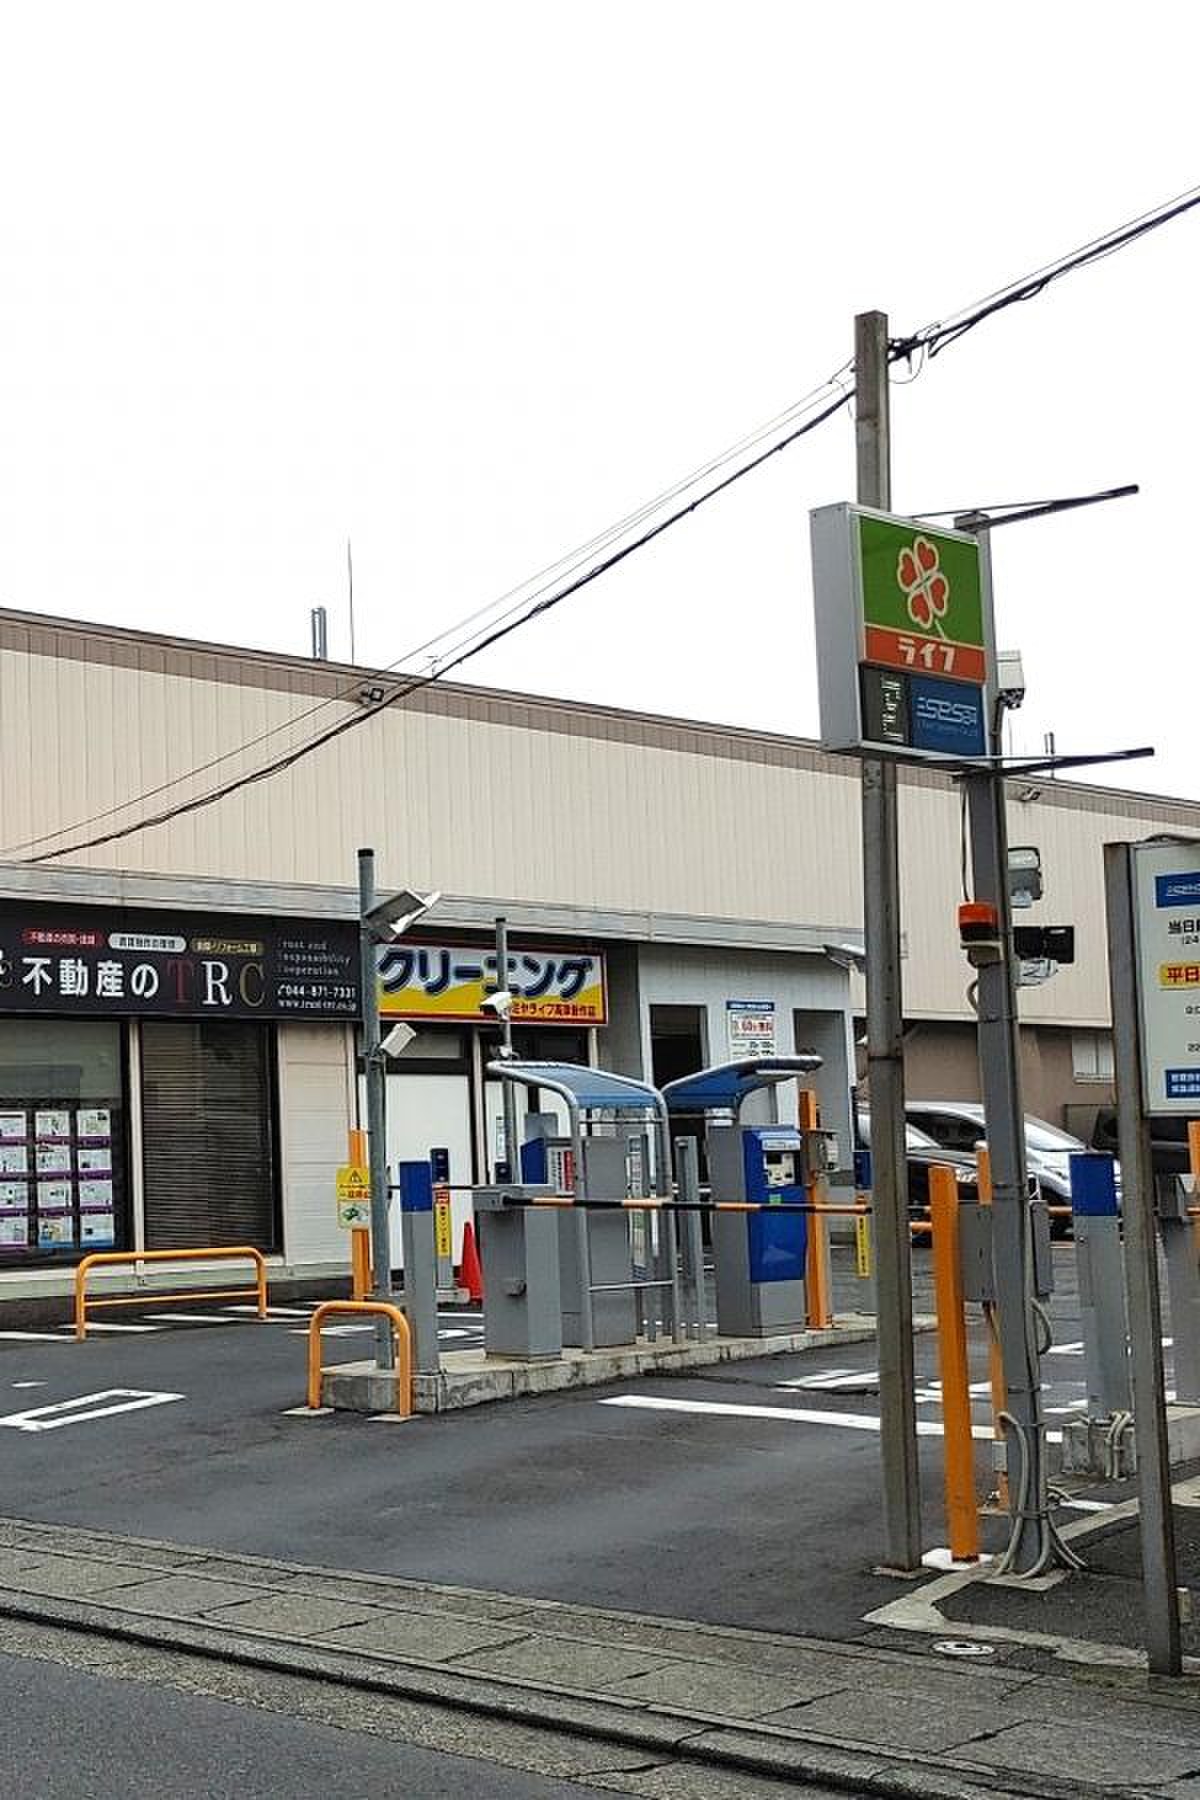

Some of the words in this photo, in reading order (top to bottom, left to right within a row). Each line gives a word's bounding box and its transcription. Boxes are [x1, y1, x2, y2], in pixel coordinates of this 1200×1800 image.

[897, 638, 956, 673] ライフ
[1167, 919, 1200, 935] 当日
[377, 946, 594, 1001] クリーニング
